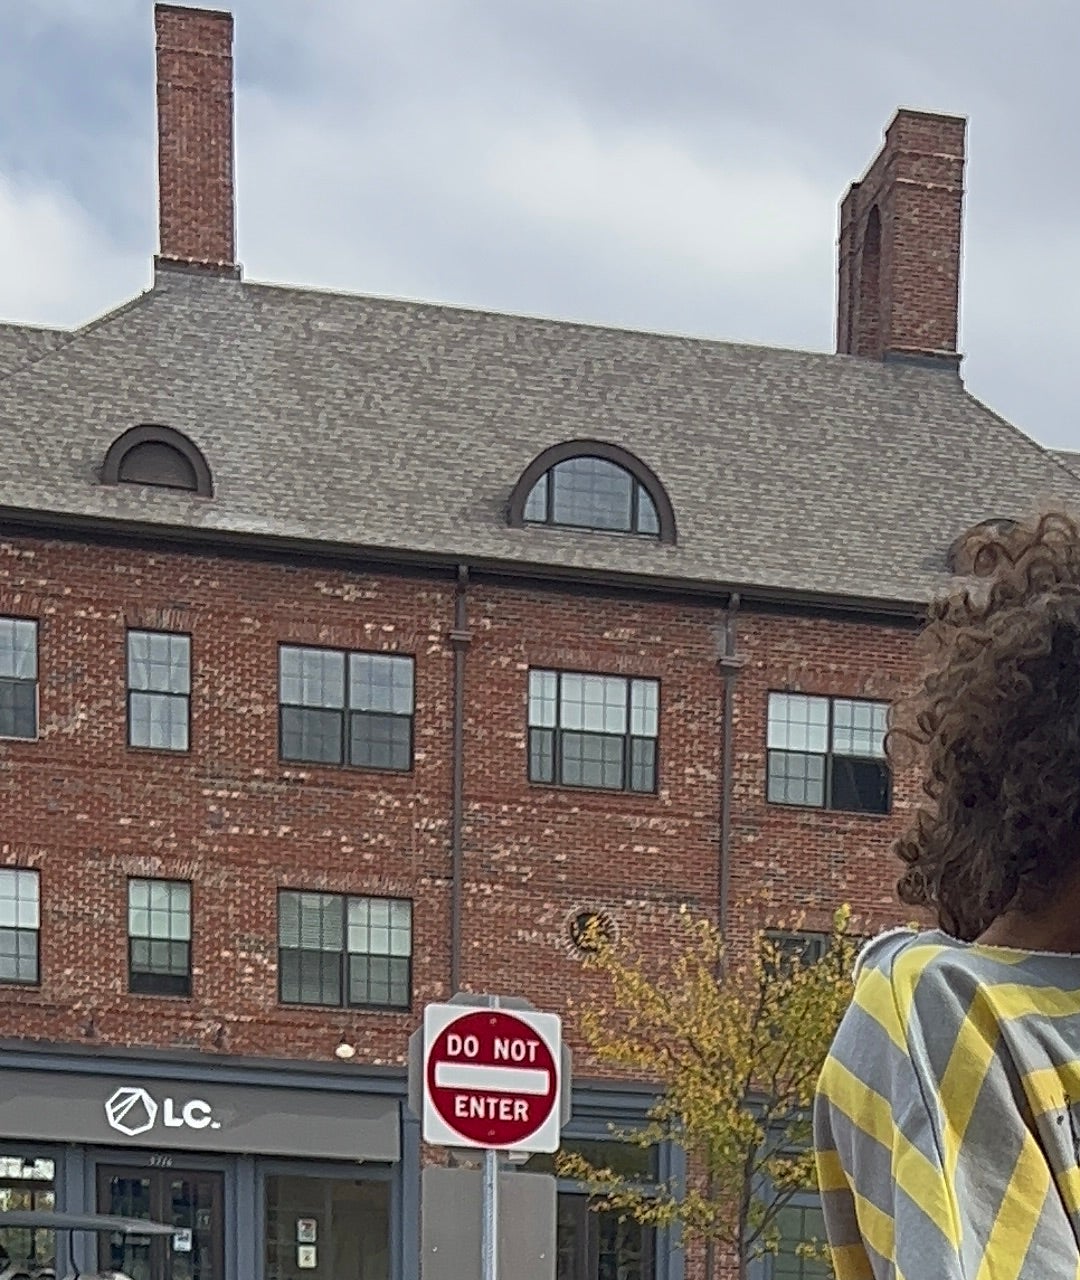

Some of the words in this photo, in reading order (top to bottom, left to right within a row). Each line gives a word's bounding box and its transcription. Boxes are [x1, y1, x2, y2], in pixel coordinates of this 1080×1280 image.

[447, 1034, 479, 1058] DO
[494, 1037, 540, 1063] NOT
[455, 1094, 529, 1122] ENTER
